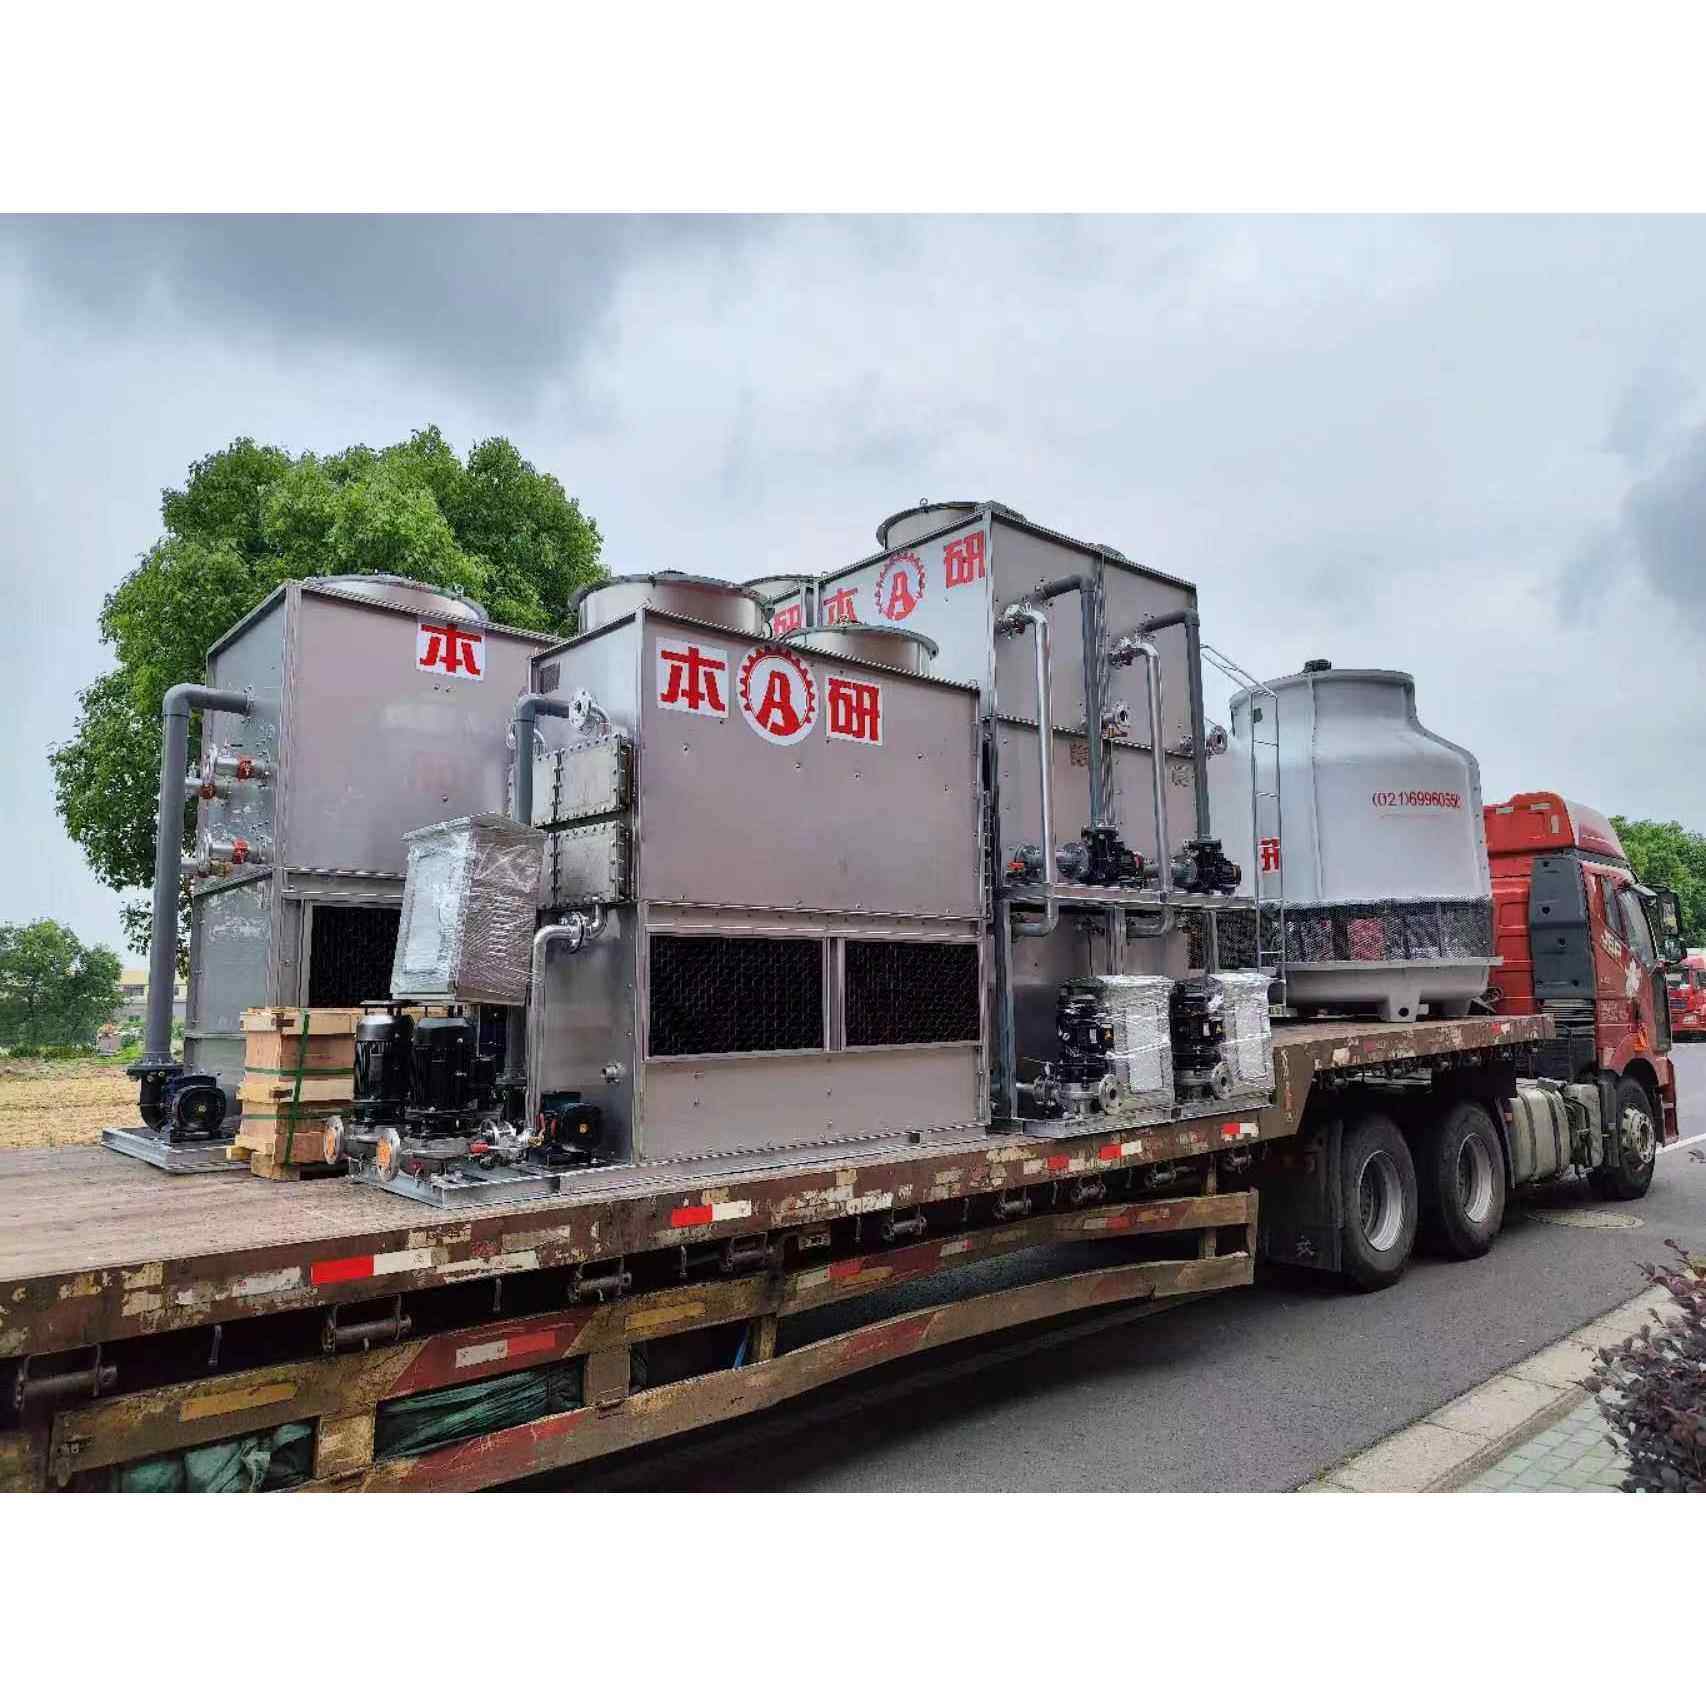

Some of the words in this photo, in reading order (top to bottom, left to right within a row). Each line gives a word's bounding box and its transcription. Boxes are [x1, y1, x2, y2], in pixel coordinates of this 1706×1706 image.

[943, 530, 986, 589] 研
[420, 623, 482, 676] 本
[661, 646, 726, 712] 本
[828, 677, 881, 742] 研
